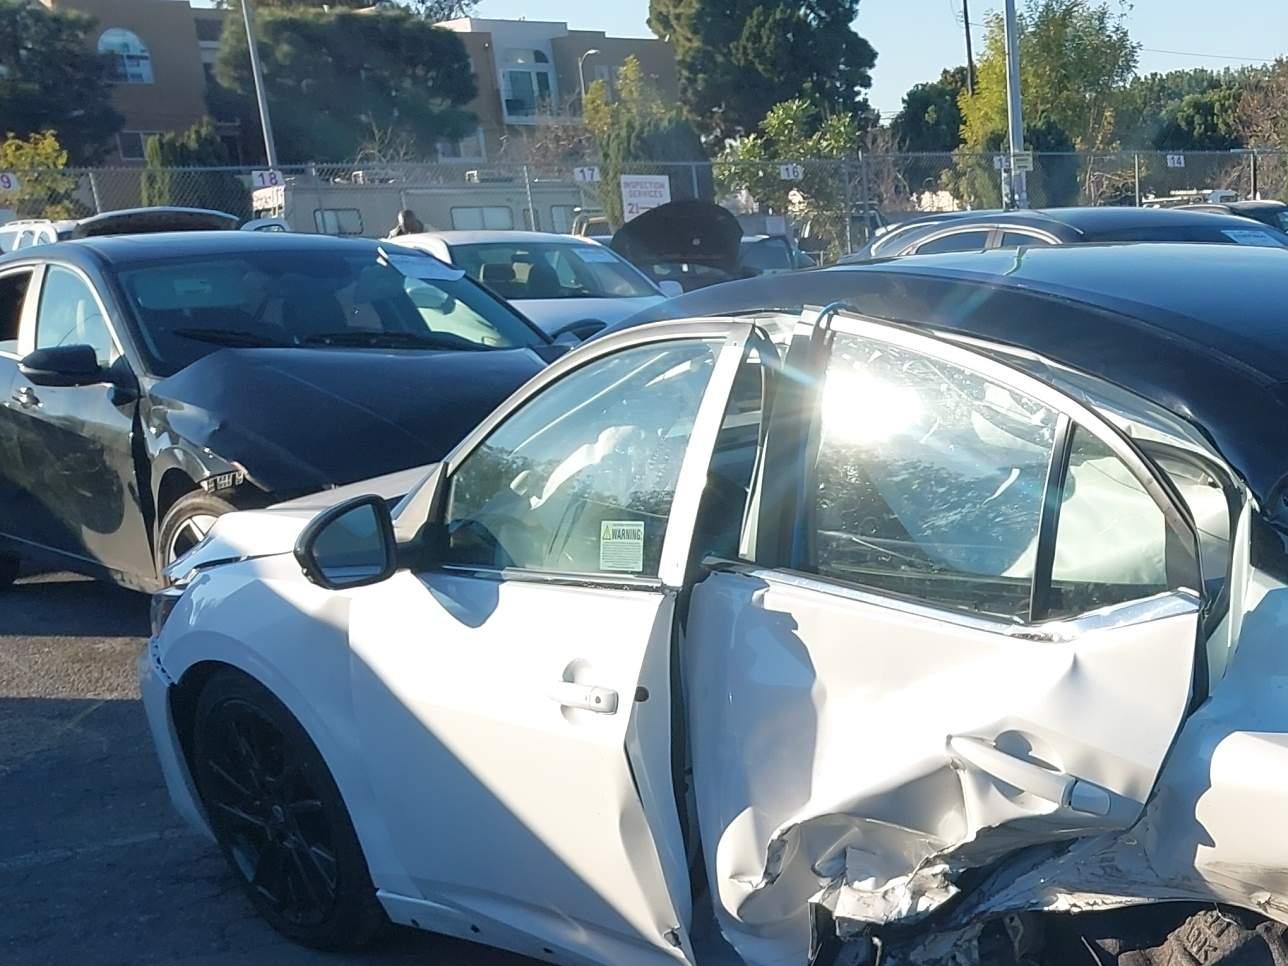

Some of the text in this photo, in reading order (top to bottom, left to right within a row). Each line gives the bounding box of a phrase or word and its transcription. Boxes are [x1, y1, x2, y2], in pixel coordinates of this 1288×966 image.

[1170, 155, 1183, 167] 14
[257, 171, 278, 186] 18
[580, 167, 595, 182] 17
[785, 166, 800, 179] 16
